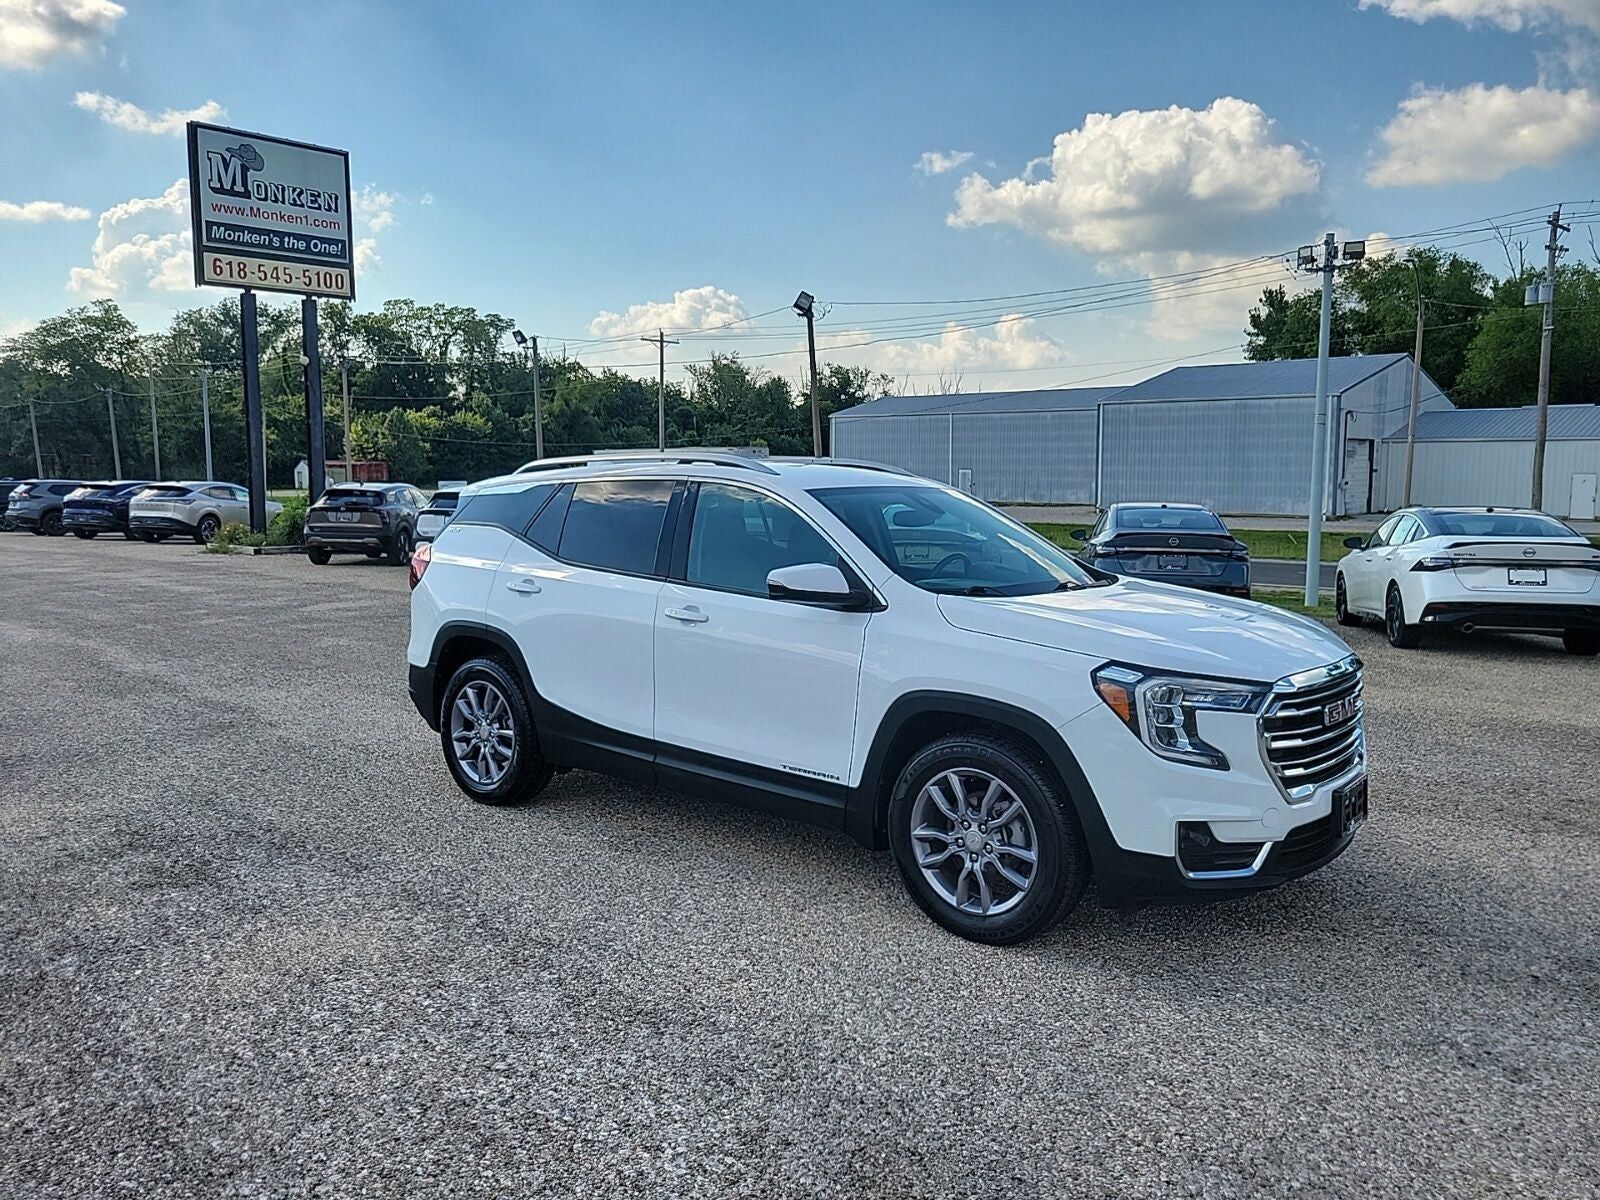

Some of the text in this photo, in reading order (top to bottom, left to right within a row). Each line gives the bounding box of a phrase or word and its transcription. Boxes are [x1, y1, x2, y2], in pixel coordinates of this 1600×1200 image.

[206, 150, 339, 213] MONKEN
[211, 202, 341, 231] www.Monken1.com
[211, 225, 342, 255] Monken's the One!
[212, 257, 345, 290] 618-545-5100
[780, 764, 840, 781] TERRAIN
